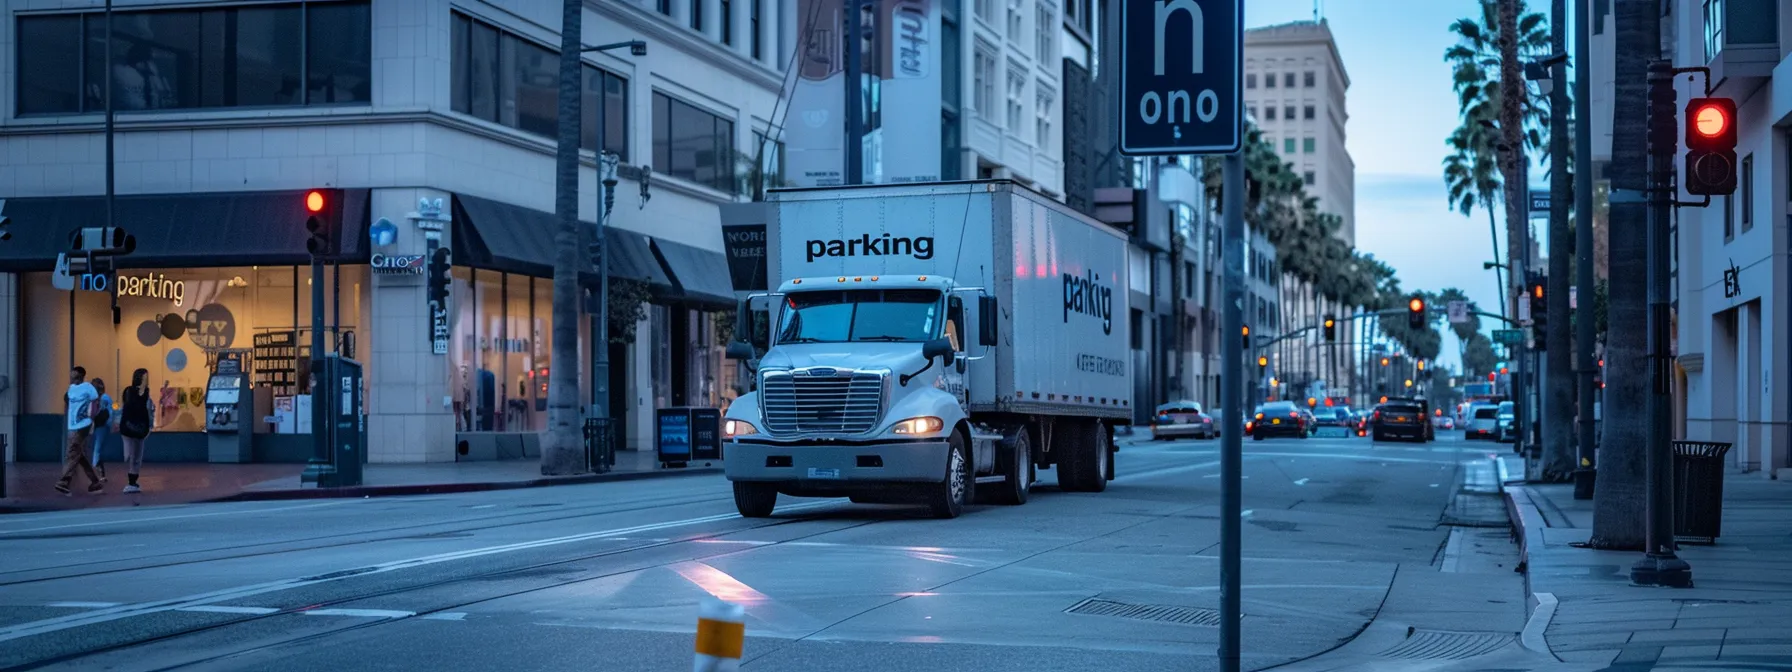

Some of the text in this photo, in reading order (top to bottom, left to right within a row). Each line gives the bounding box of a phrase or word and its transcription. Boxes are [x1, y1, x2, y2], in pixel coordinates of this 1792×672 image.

[1154, 0, 1204, 75] n
[1140, 89, 1219, 124] ono
[806, 233, 934, 262] parking
[81, 272, 185, 307] no parking
